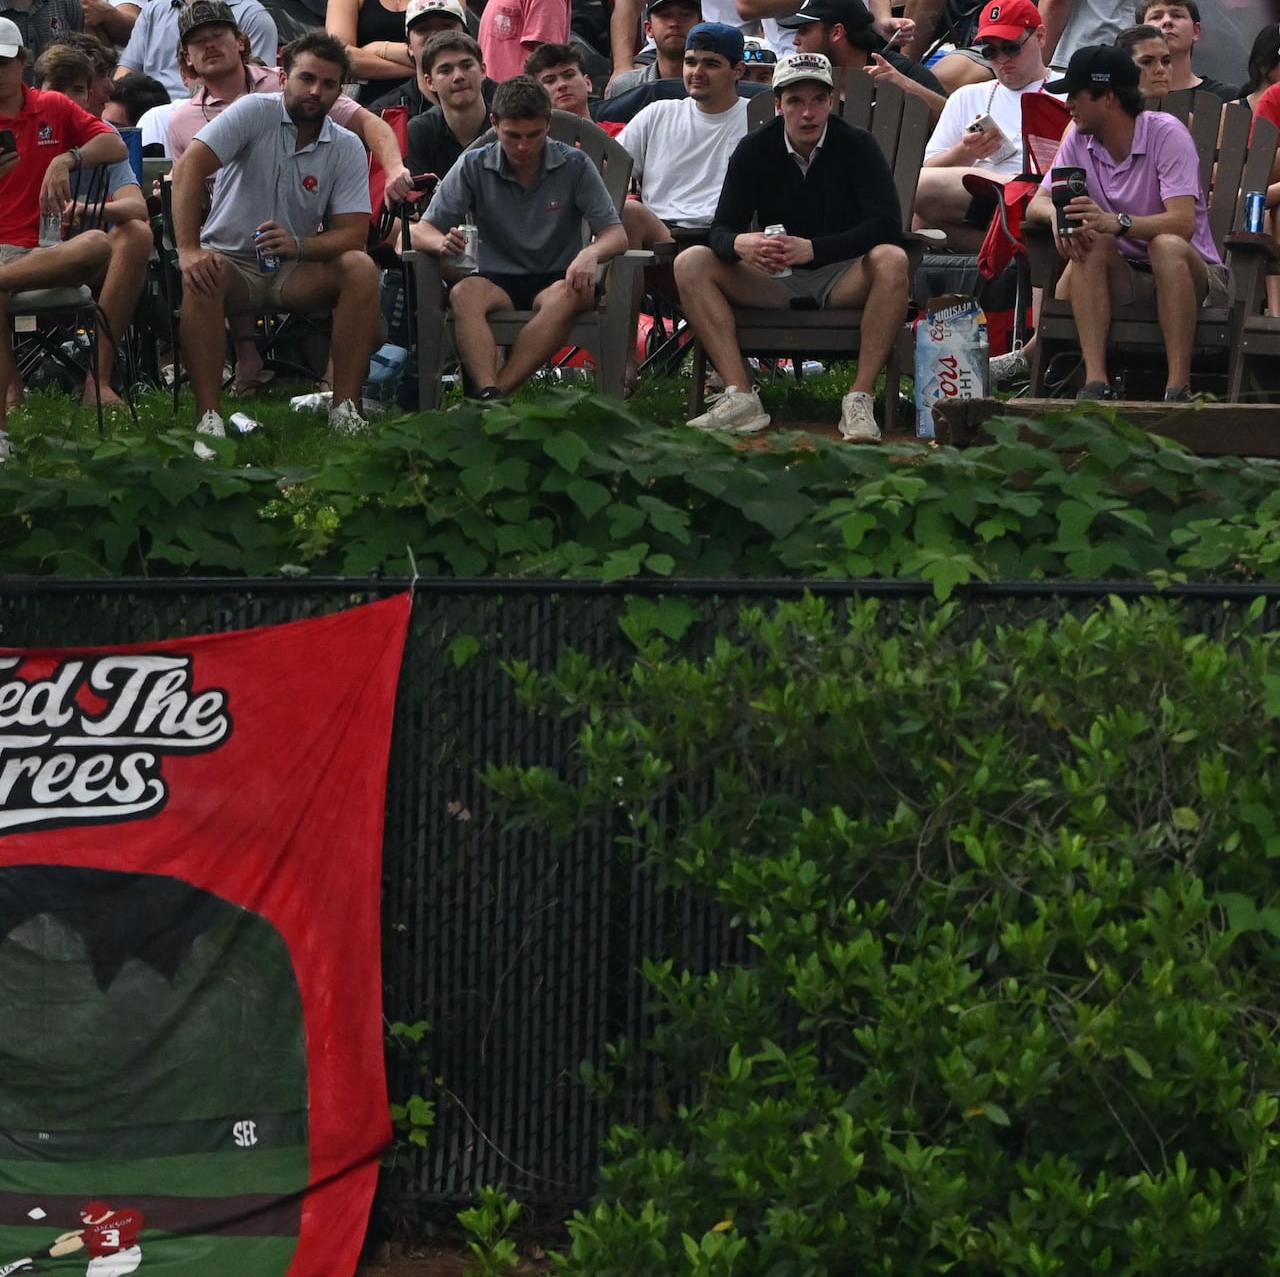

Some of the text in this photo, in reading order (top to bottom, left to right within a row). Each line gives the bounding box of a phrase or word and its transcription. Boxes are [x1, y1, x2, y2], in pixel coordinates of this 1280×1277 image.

[788, 55, 827, 65] ATLANTA
[81, 655, 228, 746] The
[232, 1120, 258, 1147] SEC
[93, 1217, 132, 1233] JACKSON
[100, 1229, 120, 1247] 3
